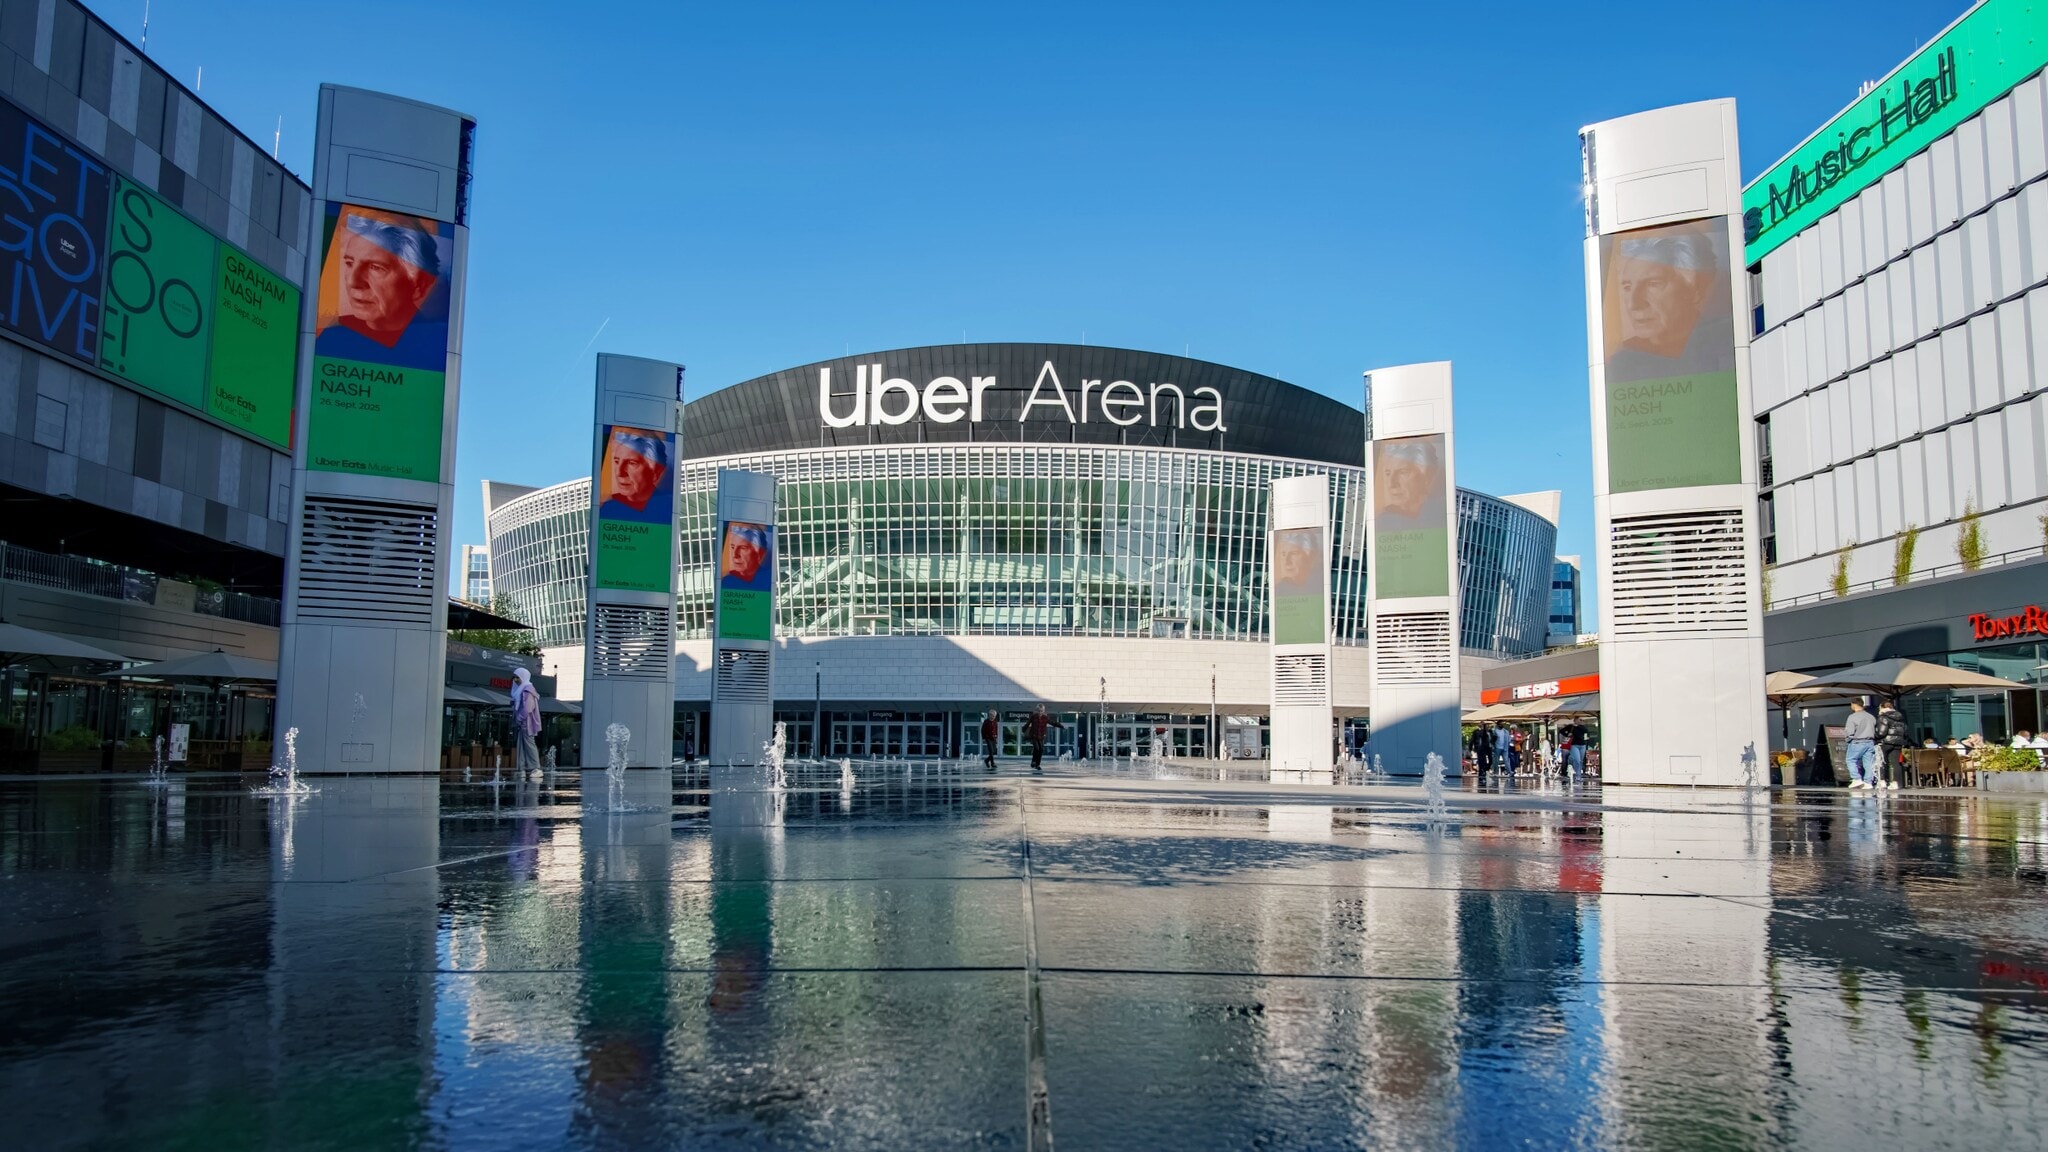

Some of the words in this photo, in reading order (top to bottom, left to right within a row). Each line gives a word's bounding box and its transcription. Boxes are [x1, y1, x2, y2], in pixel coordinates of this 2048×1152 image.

[1769, 127, 1872, 224] Music
[1880, 46, 1957, 146] Hall
[226, 256, 286, 305] GRAHAM
[224, 274, 262, 311] NASH
[321, 363, 404, 386] GRAHAM
[320, 380, 371, 398] NASH
[820, 363, 996, 428] Uber
[1018, 360, 1228, 433] Arena
[1613, 381, 1692, 401] GRAHAM
[215, 386, 237, 403] Uber
[236, 396, 257, 413] Eats
[320, 397, 333, 406] 26.
[334, 399, 357, 410] Sept.
[360, 402, 381, 412] 2025
[1613, 400, 1662, 417] NASH
[315, 456, 341, 468] Uber
[341, 459, 367, 471] Eats
[367, 462, 394, 473] Music
[396, 464, 413, 475] Hall
[602, 523, 649, 535] GRAHAM
[602, 533, 631, 543] NASH
[1378, 532, 1424, 544] GRAHAM
[1379, 544, 1407, 553] NASH
[723, 591, 756, 599] GRAHAM
